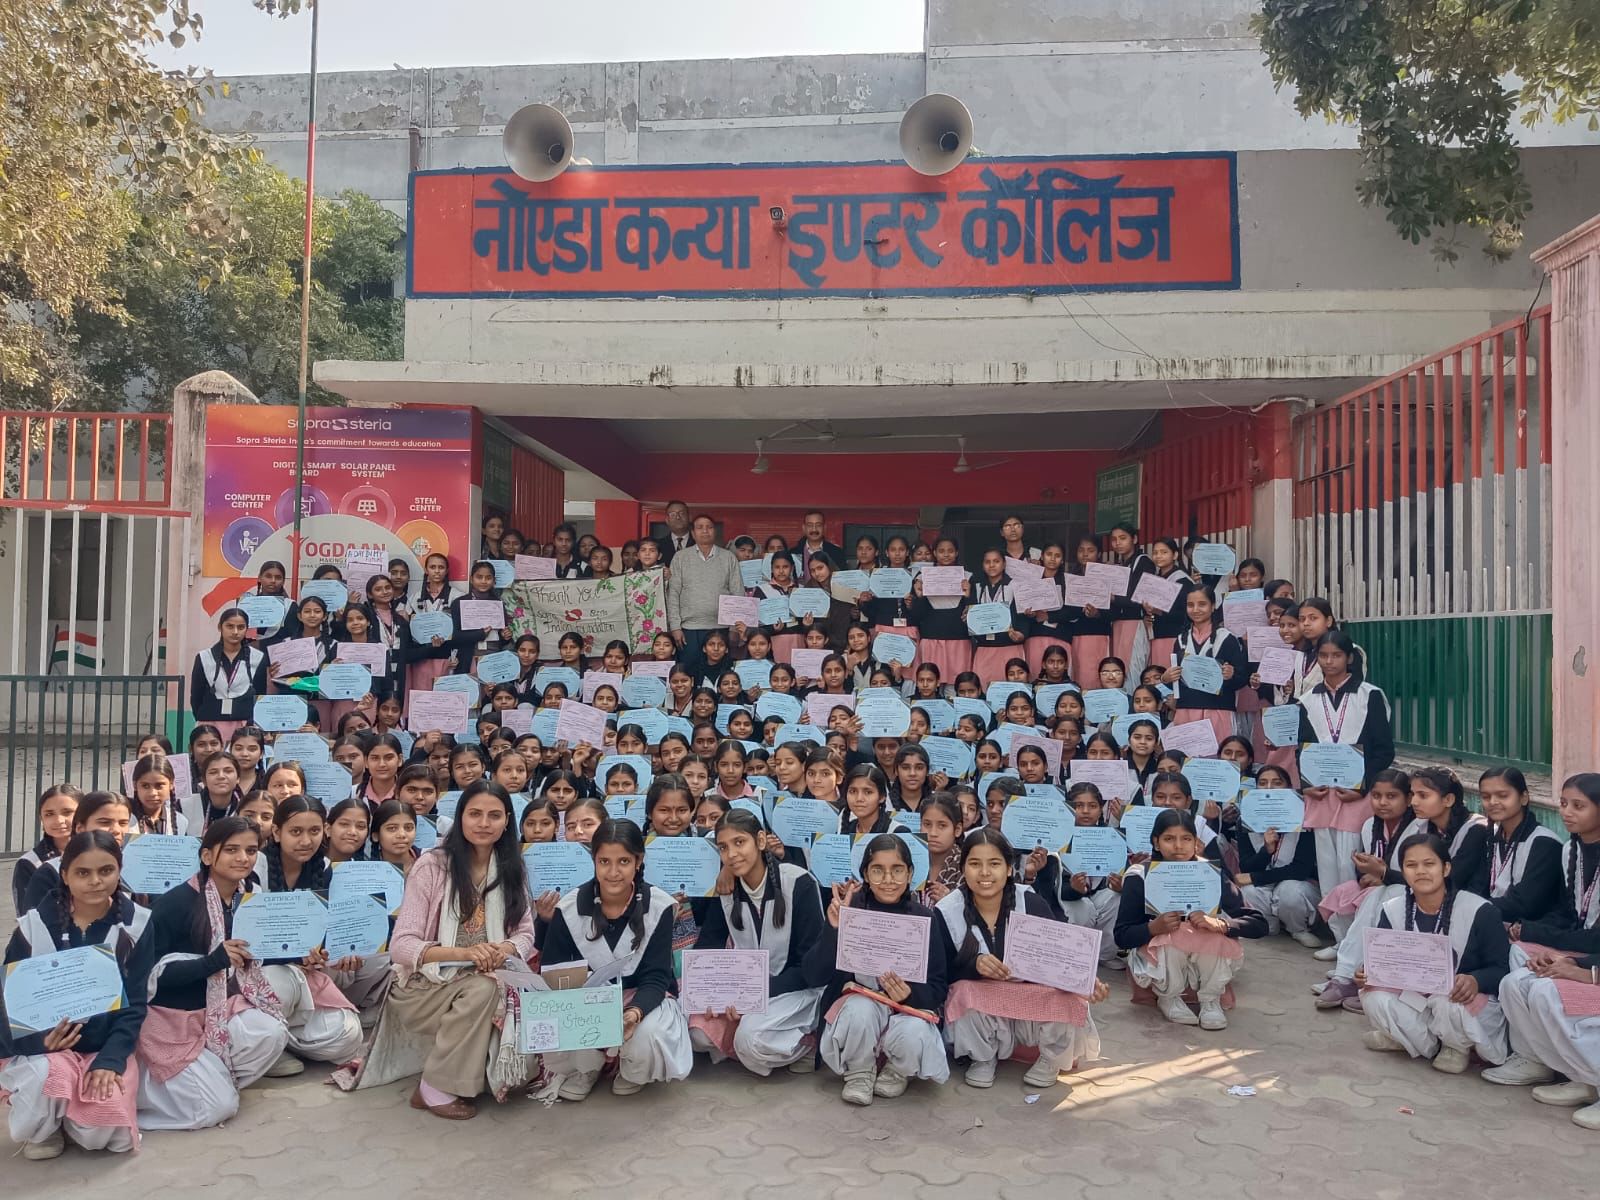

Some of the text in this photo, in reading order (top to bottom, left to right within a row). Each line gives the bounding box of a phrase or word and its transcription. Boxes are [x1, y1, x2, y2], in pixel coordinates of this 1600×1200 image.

[473, 178, 610, 277] नोएडा
[613, 195, 760, 271] कन्या
[787, 191, 947, 289] इण्टर
[349, 418, 392, 430] steria
[236, 436, 442, 448] Sopra Steria Ina's commitment towards education
[307, 462, 337, 470] SMART
[340, 463, 397, 471] SOLAR PANEL
[351, 470, 385, 478] SYSTEM
[224, 493, 271, 501] COMPUTER
[409, 504, 442, 512] CENTER
